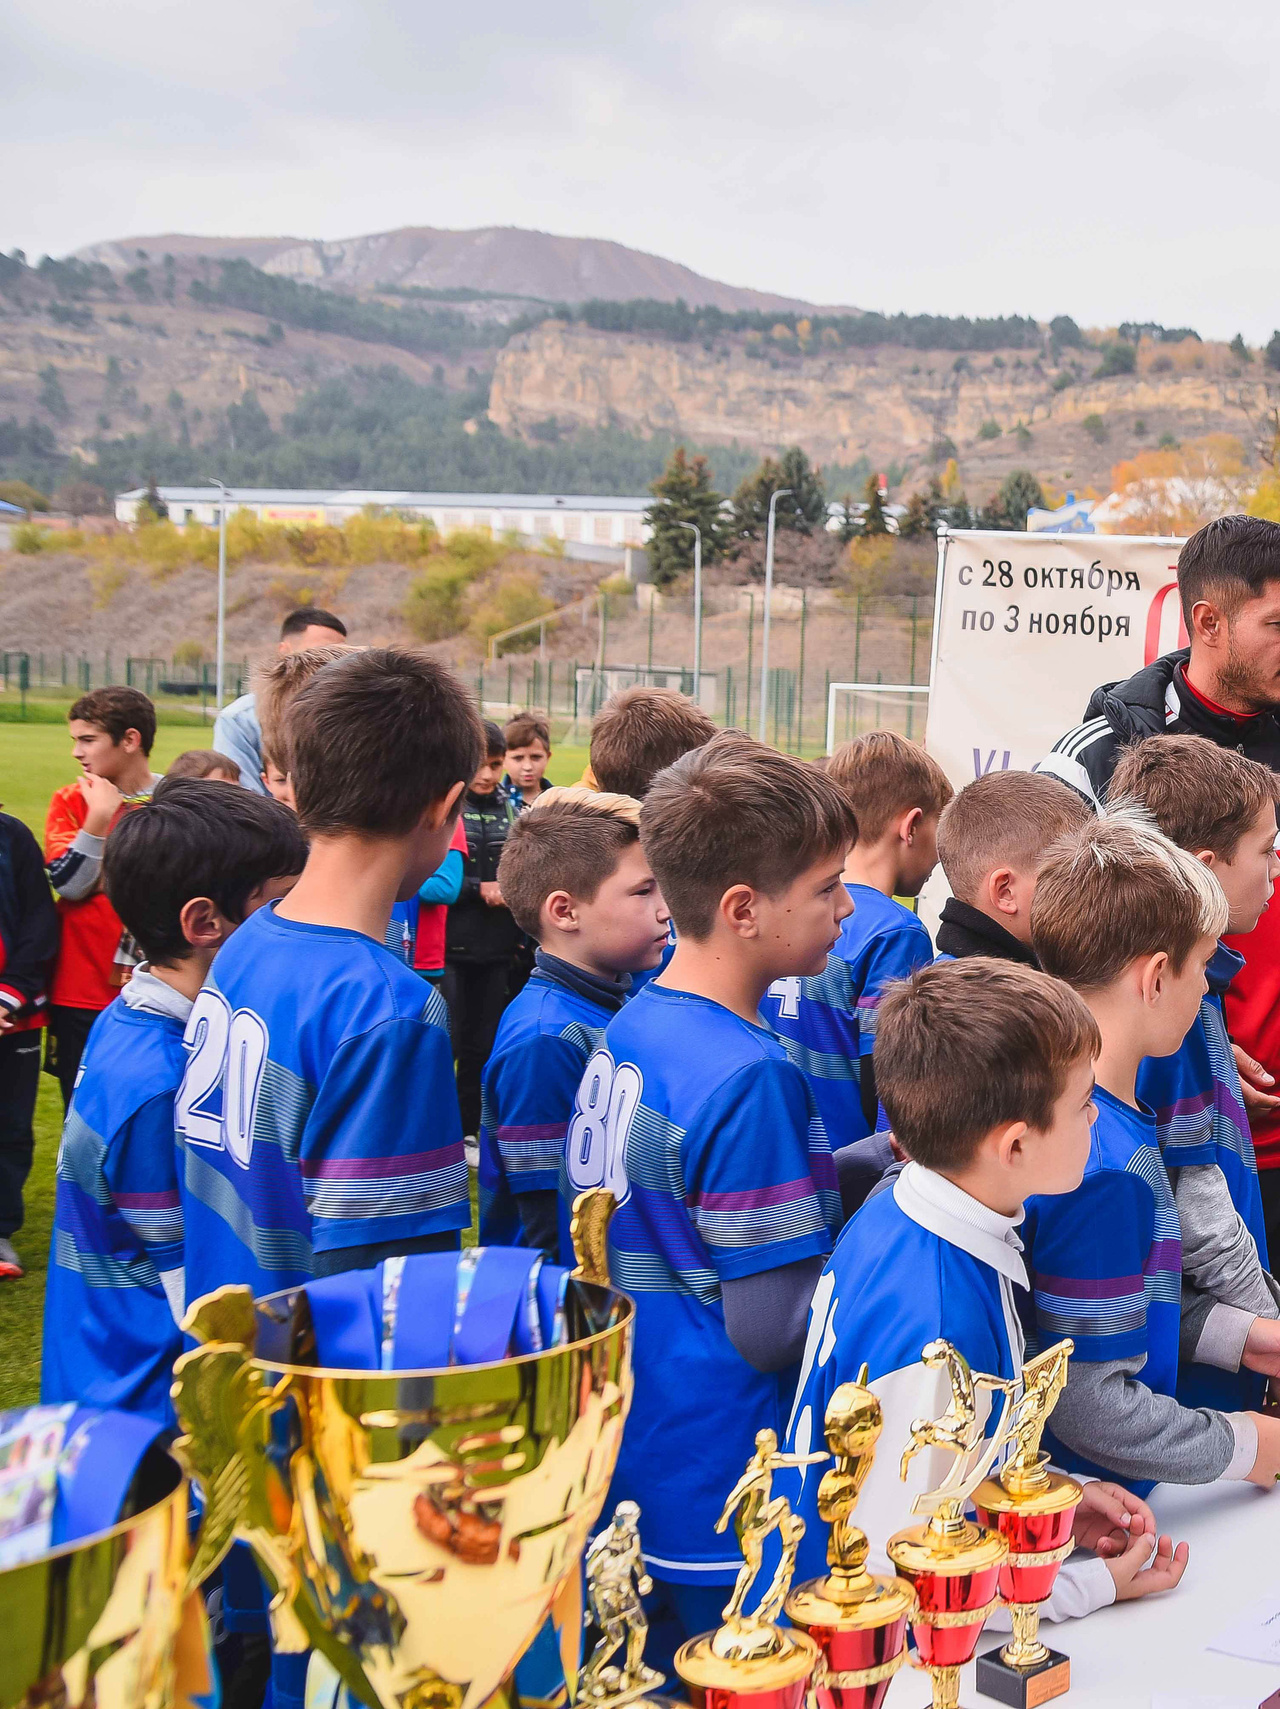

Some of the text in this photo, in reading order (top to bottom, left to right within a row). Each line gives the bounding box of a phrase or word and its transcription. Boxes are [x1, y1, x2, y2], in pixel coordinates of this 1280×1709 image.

[958, 560, 1141, 597] с 28 октября
[961, 605, 1131, 643] по 3 ноября
[174, 986, 271, 1170] 20
[566, 1048, 644, 1210] 80
